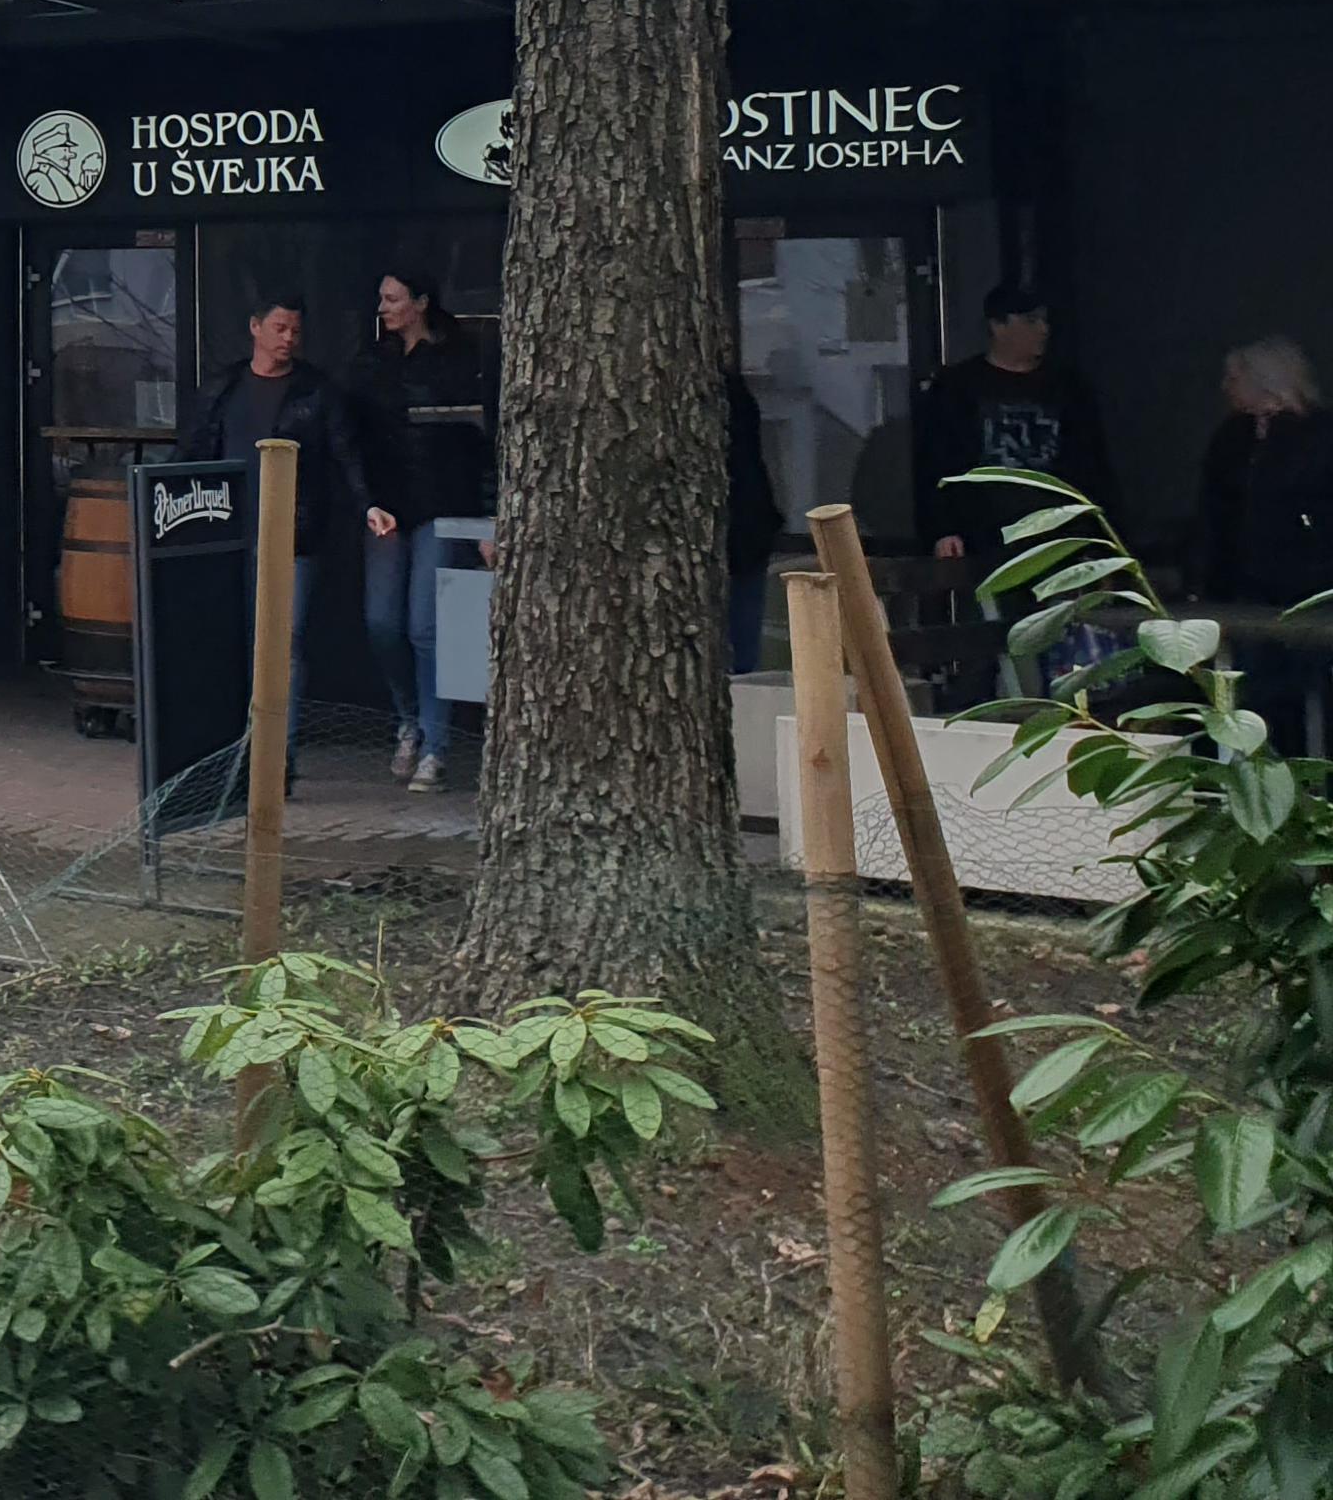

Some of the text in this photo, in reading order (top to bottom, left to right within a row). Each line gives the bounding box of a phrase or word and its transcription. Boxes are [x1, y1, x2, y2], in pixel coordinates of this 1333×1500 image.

[131, 108, 325, 150] HOSPODA
[132, 149, 326, 197] U ŠVEJKA
[803, 138, 964, 172] JOSEPHA
